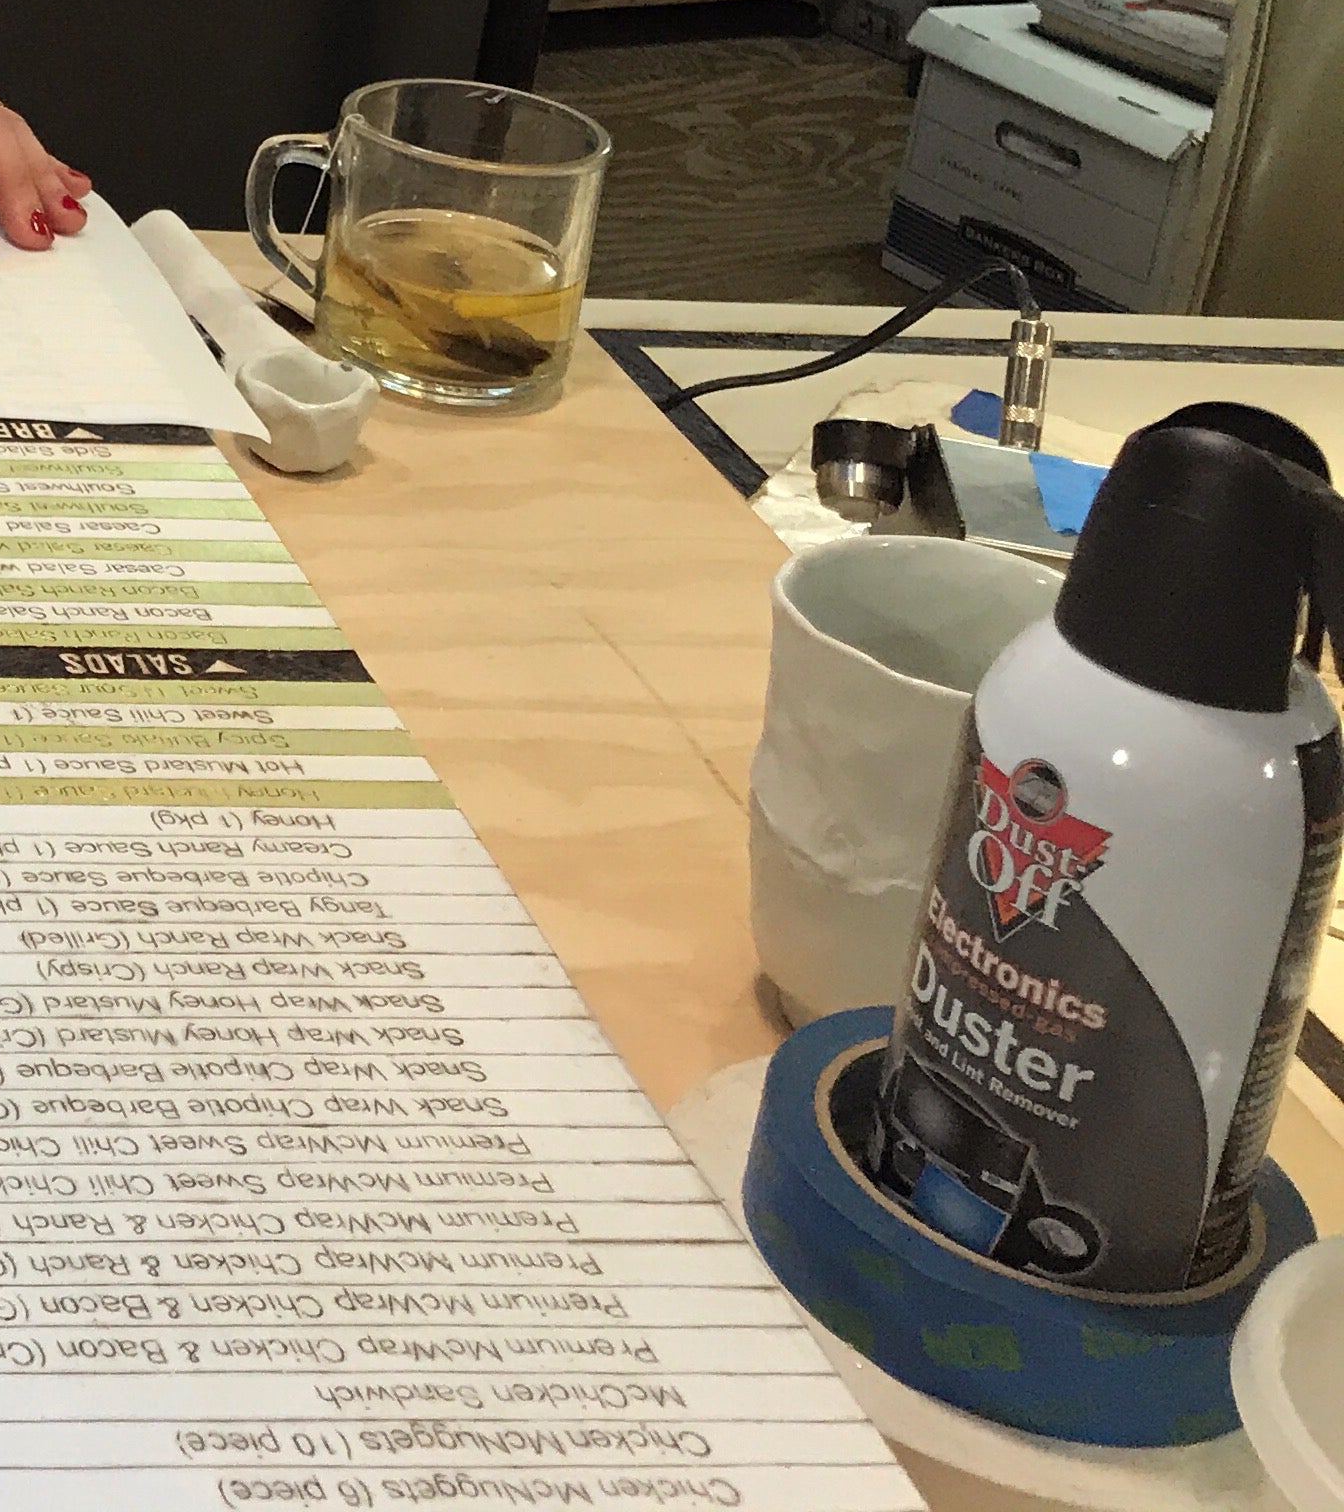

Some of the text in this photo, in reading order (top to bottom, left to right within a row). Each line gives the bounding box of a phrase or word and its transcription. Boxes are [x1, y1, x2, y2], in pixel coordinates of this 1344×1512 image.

[65, 446, 112, 458] Side
[51, 606, 138, 621] Ranch
[136, 607, 213, 622] Bacon
[57, 651, 192, 676] SALADS
[24, 758, 47, 775] (1
[54, 759, 137, 774] Sauce
[143, 759, 250, 775] Mustard
[255, 760, 305, 776] Hot
[149, 809, 337, 832] Honey (1 pkg)
[967, 828, 1083, 932] Off
[928, 885, 1108, 1030] Electronics
[40, 995, 165, 1019] Mustard
[168, 989, 261, 1014] Honey
[269, 990, 353, 1014] Wrap
[352, 993, 446, 1014] Snack
[912, 942, 1096, 1103] Duster
[15, 1057, 166, 1084] Barbeque
[169, 1057, 296, 1082] Chipotle
[303, 1057, 389, 1082] Wrap
[390, 1060, 488, 1083] Snack
[923, 1031, 1081, 1131] and Lint Remover
[72, 1135, 140, 1158] Chili
[147, 1133, 248, 1157] Sweet
[256, 1131, 390, 1155] McWrap
[394, 1132, 533, 1156] Premium
[39, 1293, 153, 1324] Bacon
[156, 1296, 182, 1320] &
[188, 1292, 325, 1320] Chicken
[333, 1289, 477, 1317] McWrap
[480, 1292, 630, 1319] Premium
[55, 1338, 169, 1365] Bacon
[177, 1340, 201, 1364] &
[210, 1337, 348, 1364] Chicken
[356, 1334, 503, 1363] McWrap
[503, 1337, 660, 1364] Premium
[313, 1382, 688, 1412] McChicken Sandwich
[174, 1425, 714, 1461] Chicken McNuggets (10 piece)
[217, 1473, 742, 1511] Chicken McNuggets (6 piece)
